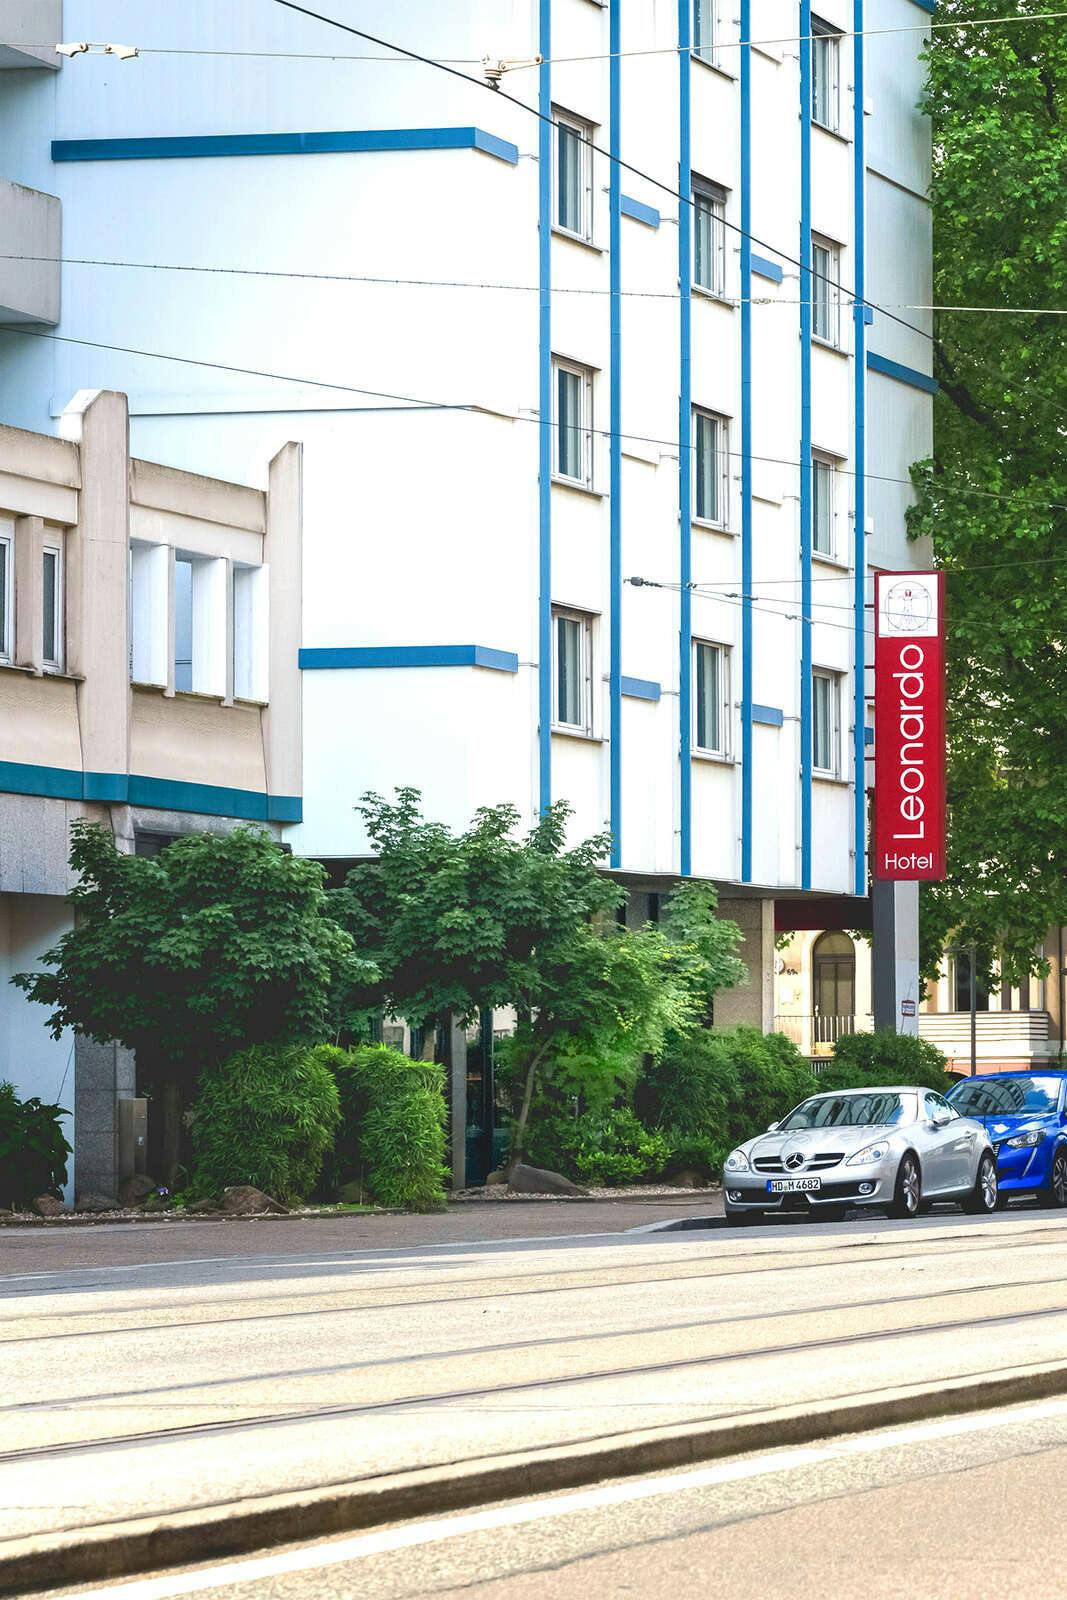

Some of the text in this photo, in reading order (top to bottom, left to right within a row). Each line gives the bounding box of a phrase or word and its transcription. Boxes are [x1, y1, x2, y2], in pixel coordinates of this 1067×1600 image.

[892, 644, 925, 839] Leonardo
[885, 852, 933, 870] Hotel
[796, 1179, 819, 1190] 4682
